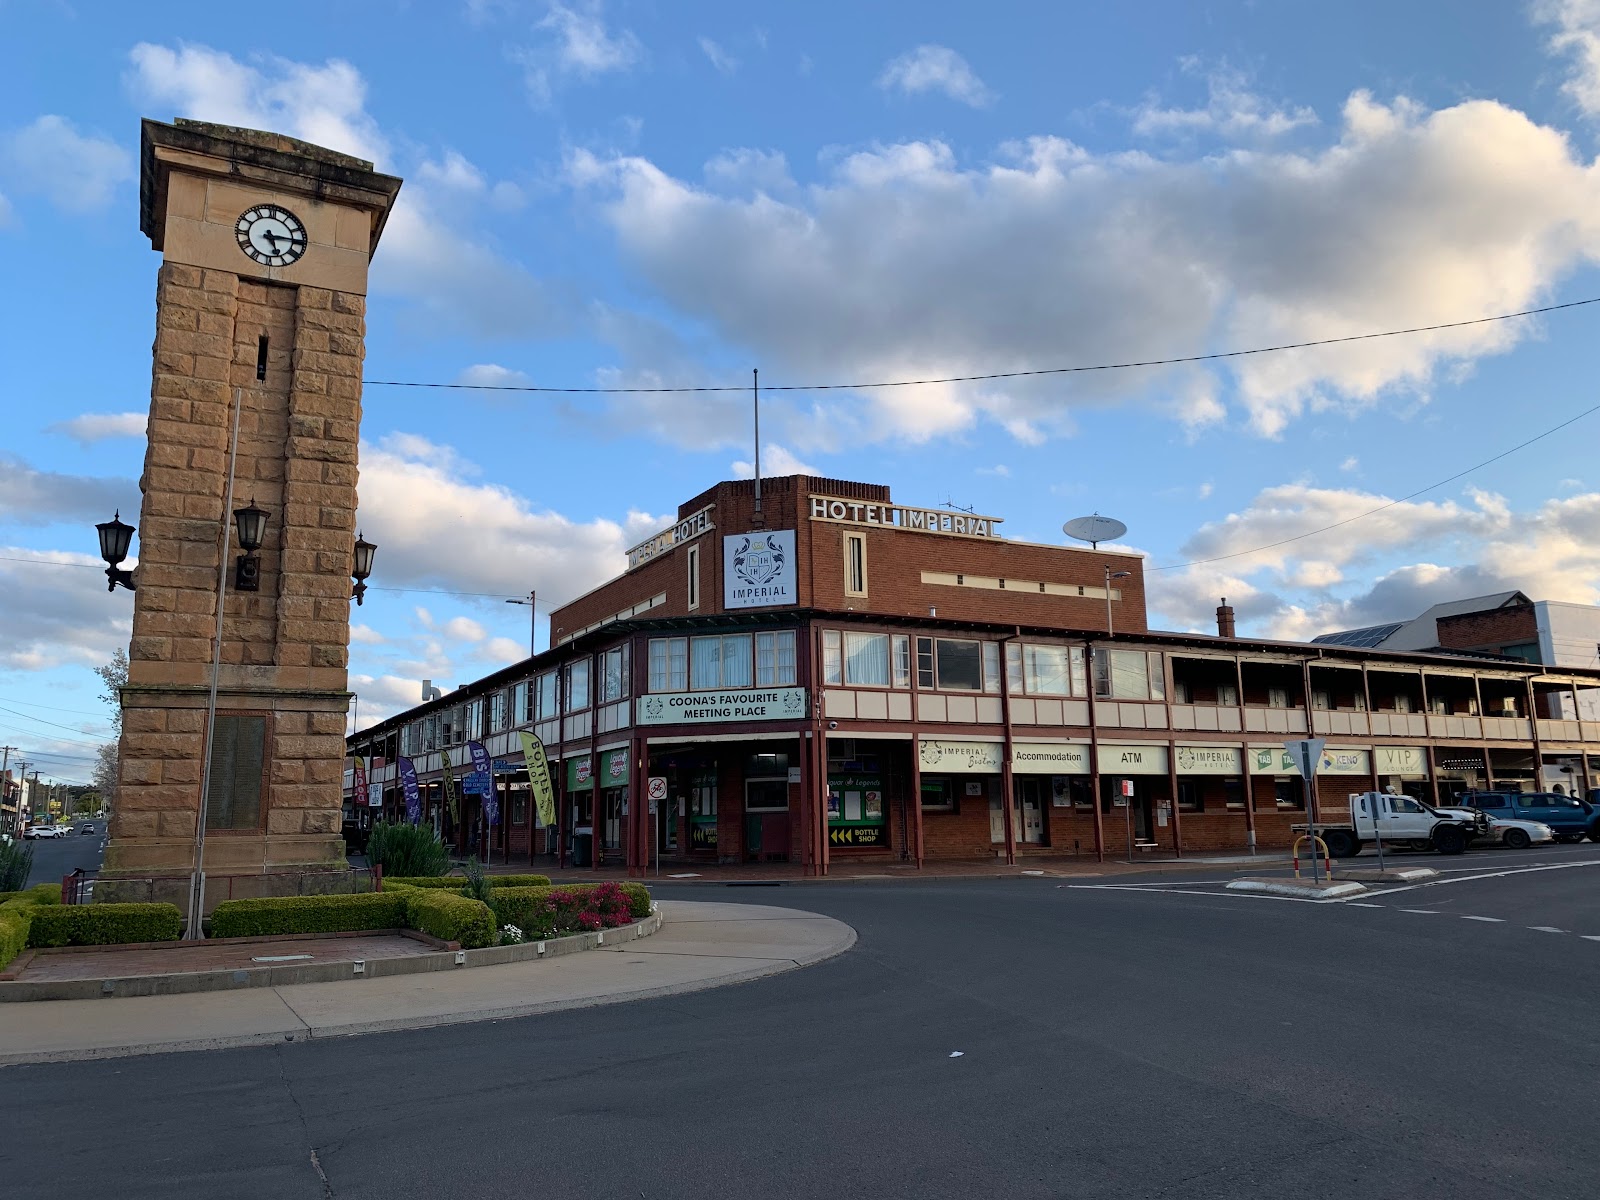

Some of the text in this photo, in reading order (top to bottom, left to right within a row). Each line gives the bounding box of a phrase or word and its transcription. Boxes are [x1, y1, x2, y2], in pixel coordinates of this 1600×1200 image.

[812, 498, 1002, 538] HOTEL IMPERIAL
[672, 509, 712, 544] HOTEL
[733, 585, 787, 599] IMPERIAL
[669, 693, 778, 707] COONA'S FAVOURITE
[684, 706, 766, 719] MEETING PLACE
[944, 747, 985, 756] IMPERIAL
[1016, 750, 1082, 762] Accommodation
[1121, 752, 1142, 763] ATM
[1196, 752, 1236, 762] IMPERIAL
[1385, 750, 1411, 765] VIP
[968, 754, 997, 769] Bistro
[1258, 755, 1271, 764] TAB
[1335, 755, 1358, 765] KENO
[526, 755, 539, 786] SHOP
[531, 740, 549, 795] BOTTLE
[405, 768, 419, 800] VIP
[855, 779, 881, 787] Legends
